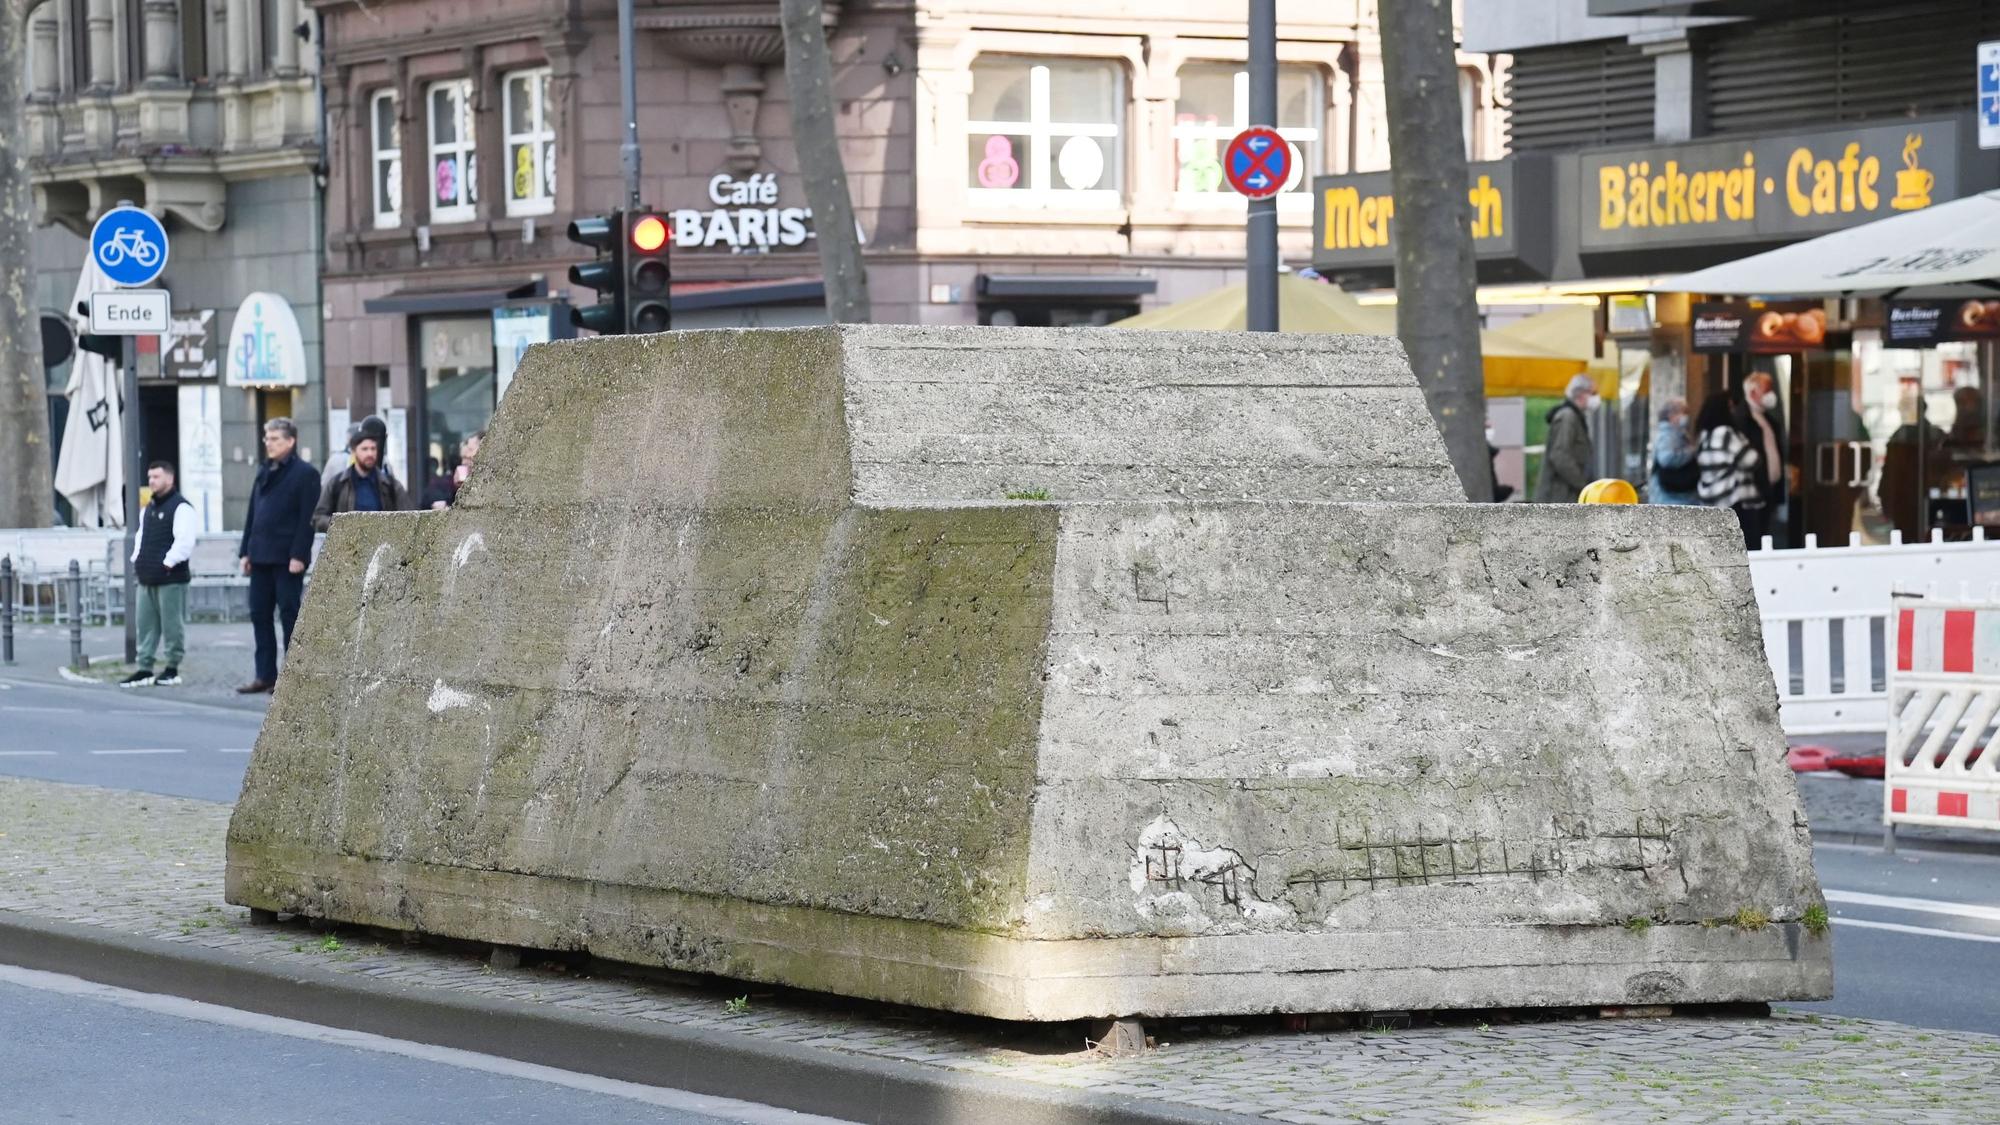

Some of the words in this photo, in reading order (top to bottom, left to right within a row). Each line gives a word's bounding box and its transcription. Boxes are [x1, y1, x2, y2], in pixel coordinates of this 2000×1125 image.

[708, 173, 779, 205] Café
[1599, 150, 1755, 229] Bäckerei
[1785, 141, 1880, 217] Cafe
[675, 208, 866, 248] BARIS
[107, 304, 153, 321] Ende
